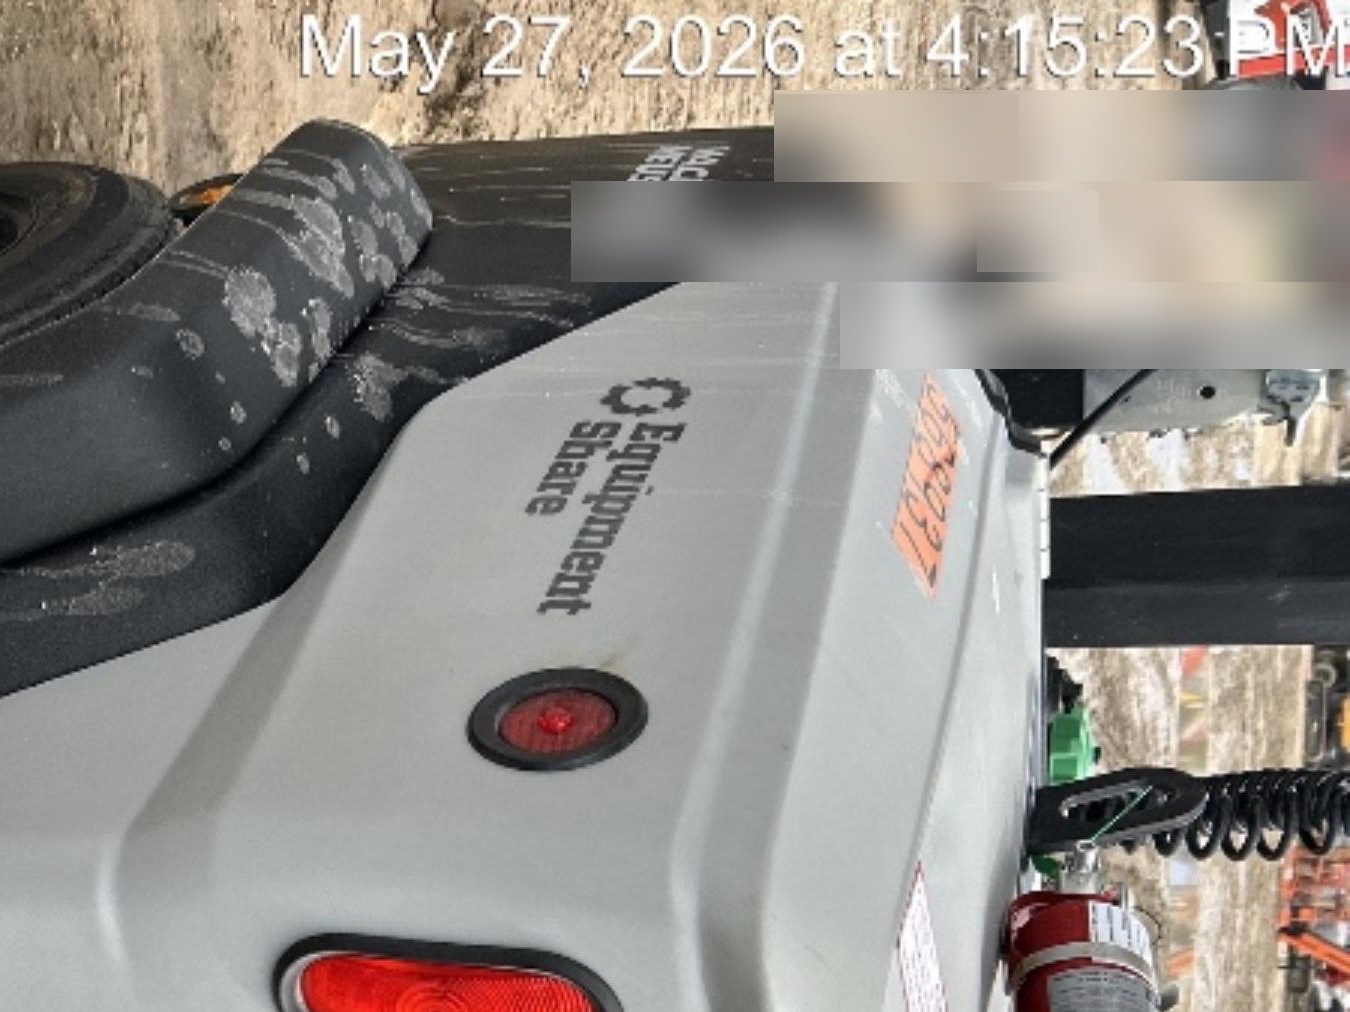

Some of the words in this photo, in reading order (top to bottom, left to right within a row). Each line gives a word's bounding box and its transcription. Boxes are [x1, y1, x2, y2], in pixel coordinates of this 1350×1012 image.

[667, 145, 730, 181] WAC
[524, 421, 621, 516] Share
[536, 422, 687, 615] Equipment
[897, 384, 960, 591] 568937
